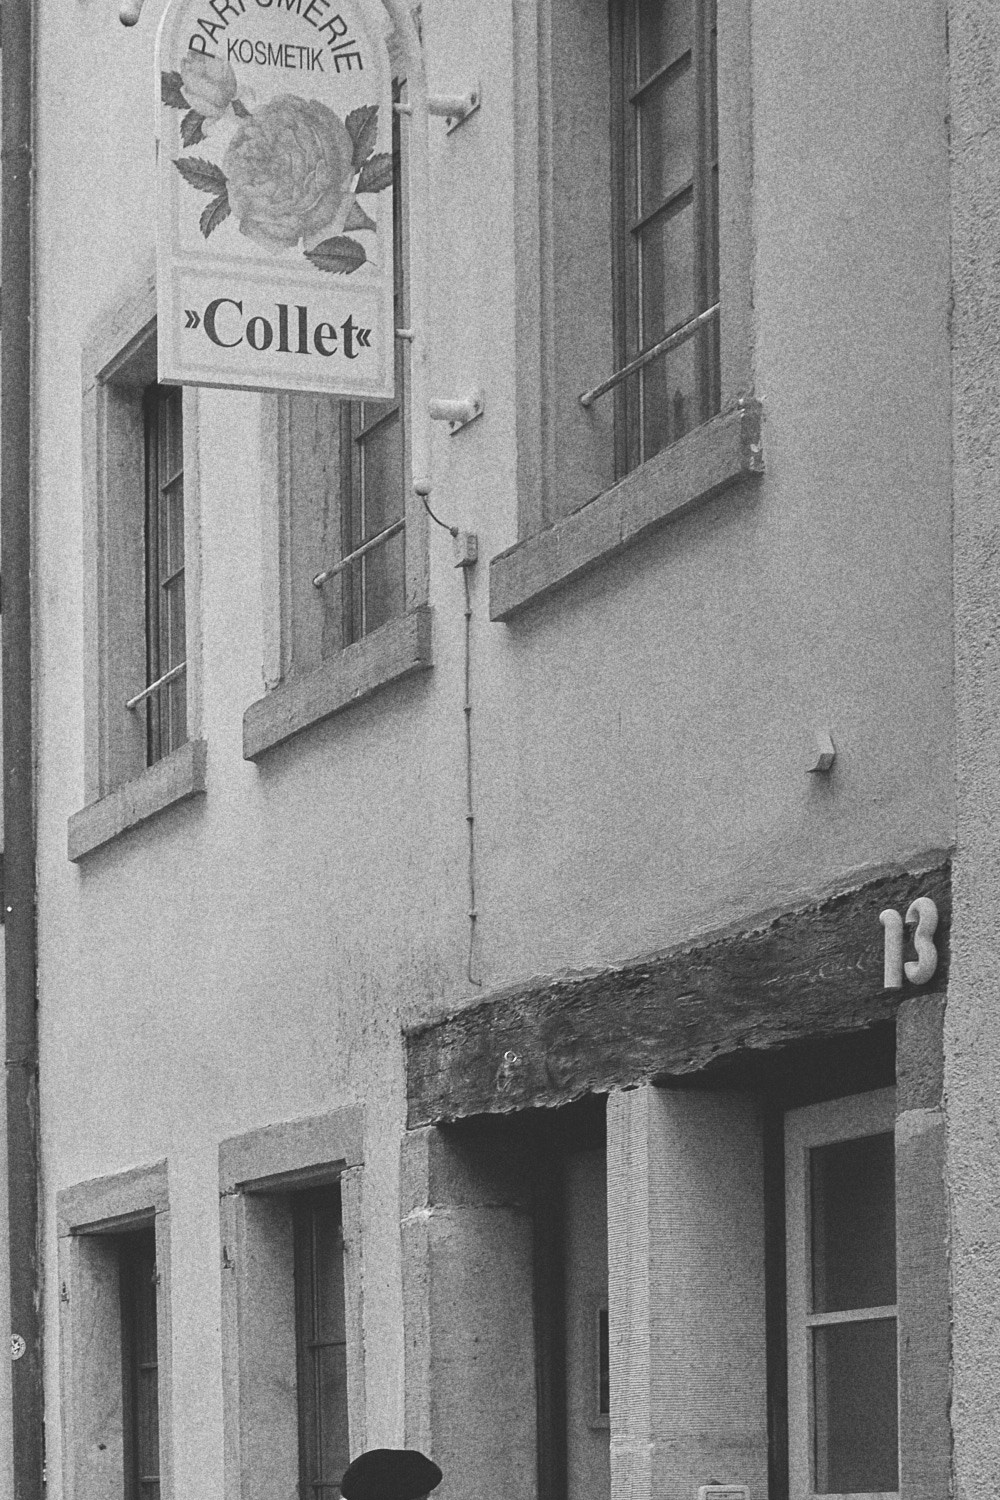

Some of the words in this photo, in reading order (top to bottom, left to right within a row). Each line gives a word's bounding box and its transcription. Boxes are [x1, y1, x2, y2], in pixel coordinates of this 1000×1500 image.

[188, 0, 363, 73] PARERIE
[226, 37, 325, 72] KOSMETIK
[879, 896, 939, 989] 13
